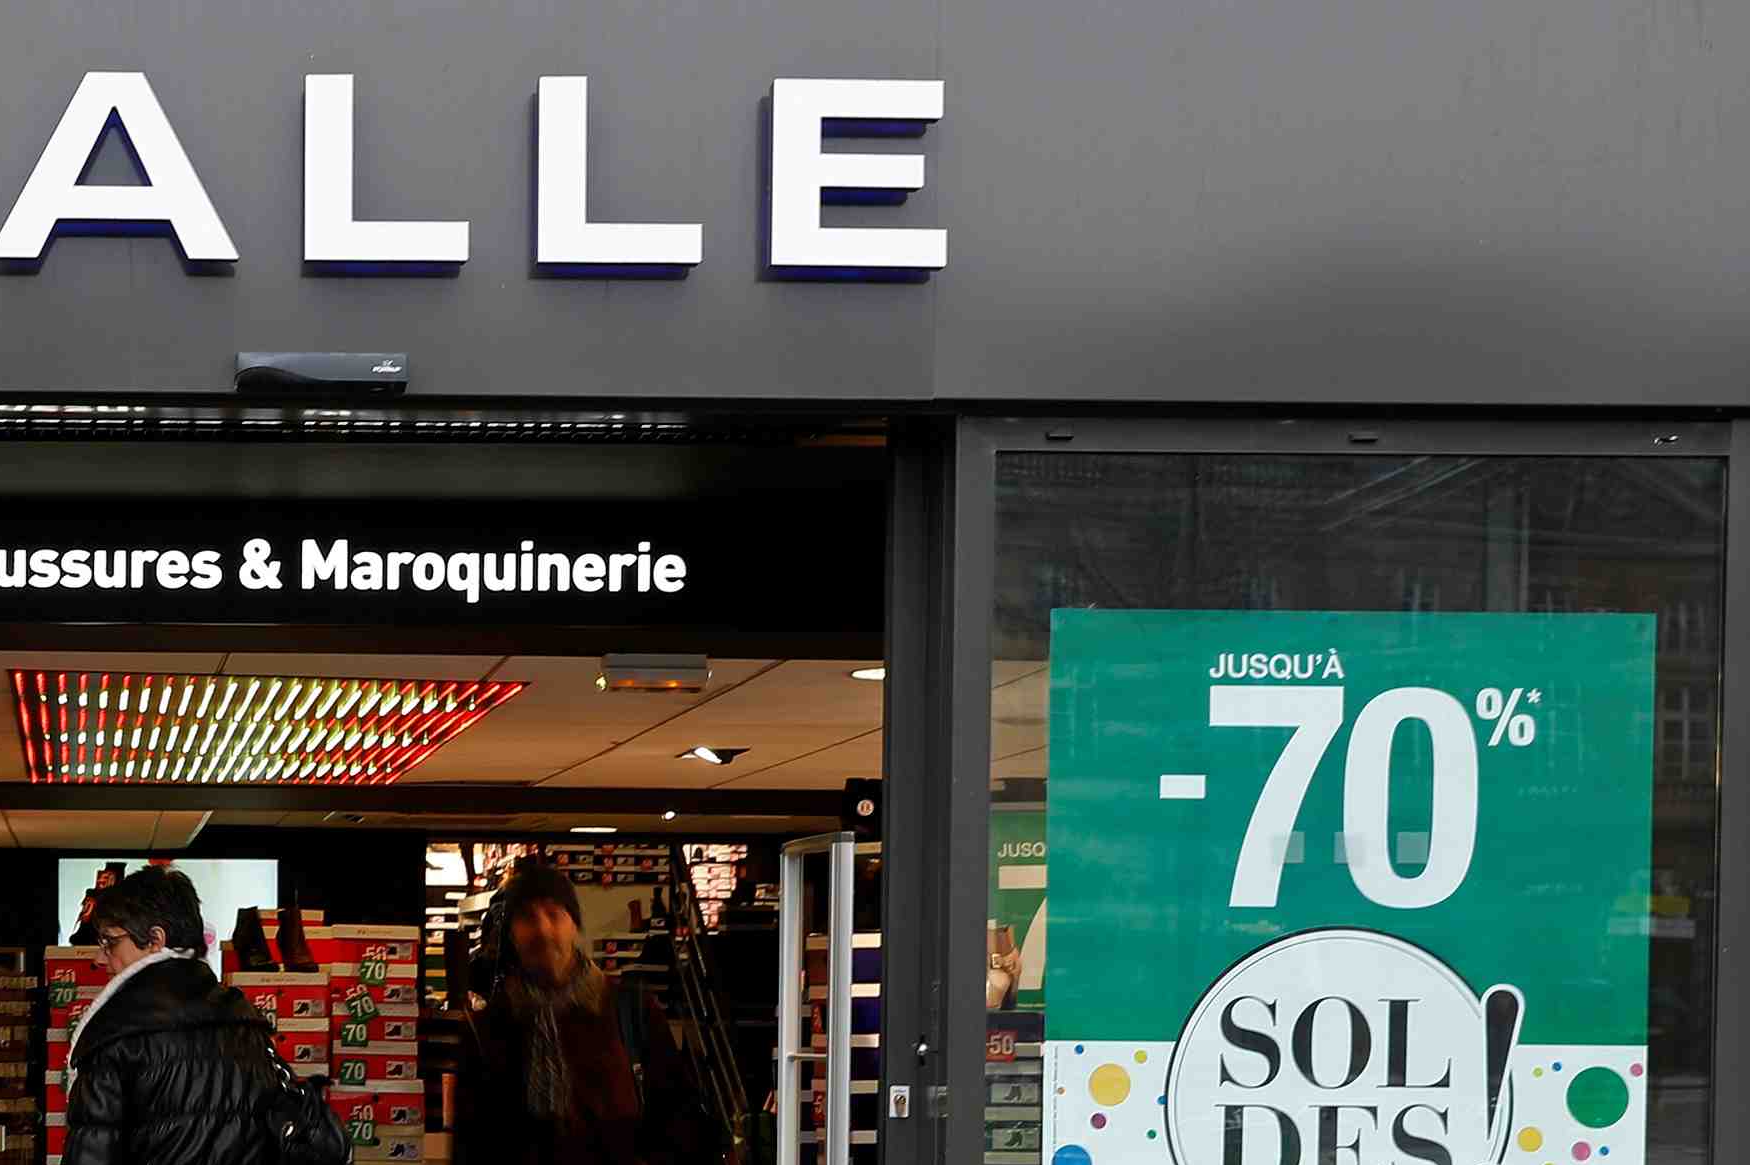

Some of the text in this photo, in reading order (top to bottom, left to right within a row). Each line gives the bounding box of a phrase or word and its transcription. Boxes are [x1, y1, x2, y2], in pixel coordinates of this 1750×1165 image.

[237, 538, 283, 591] &
[299, 539, 688, 604] Maroquinerie
[1207, 649, 1346, 681] JUSQU'À
[1217, 994, 1452, 1091] SOL
